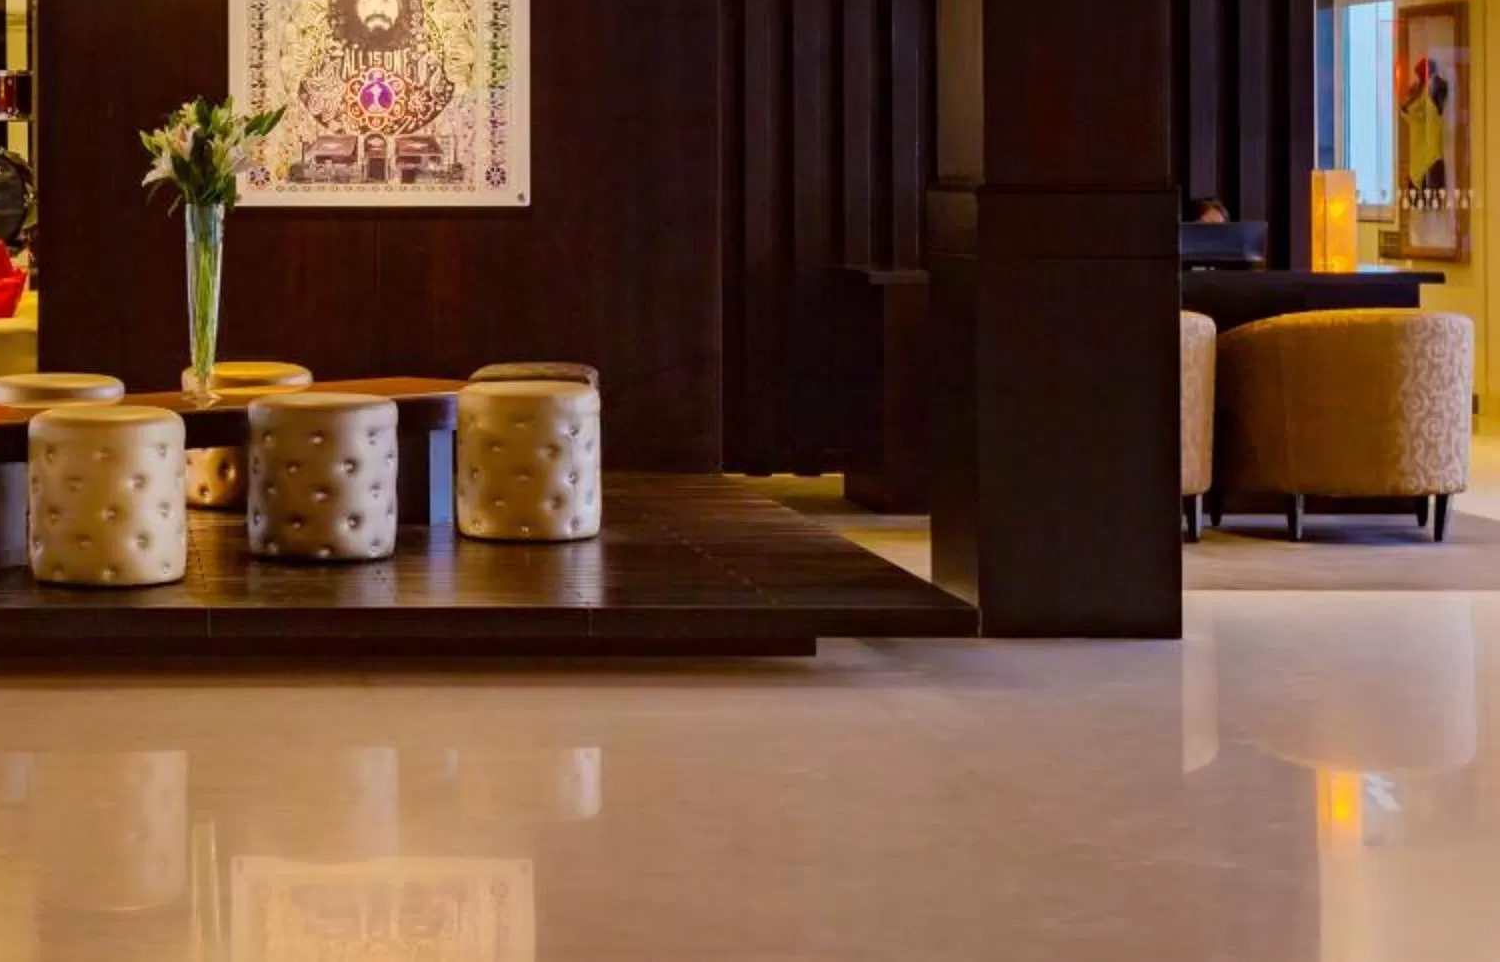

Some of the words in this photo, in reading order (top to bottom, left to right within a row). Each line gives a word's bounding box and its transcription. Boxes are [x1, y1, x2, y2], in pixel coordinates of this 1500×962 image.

[342, 48, 366, 79] ALL
[368, 51, 382, 67] IS
[384, 48, 410, 77] ONE
